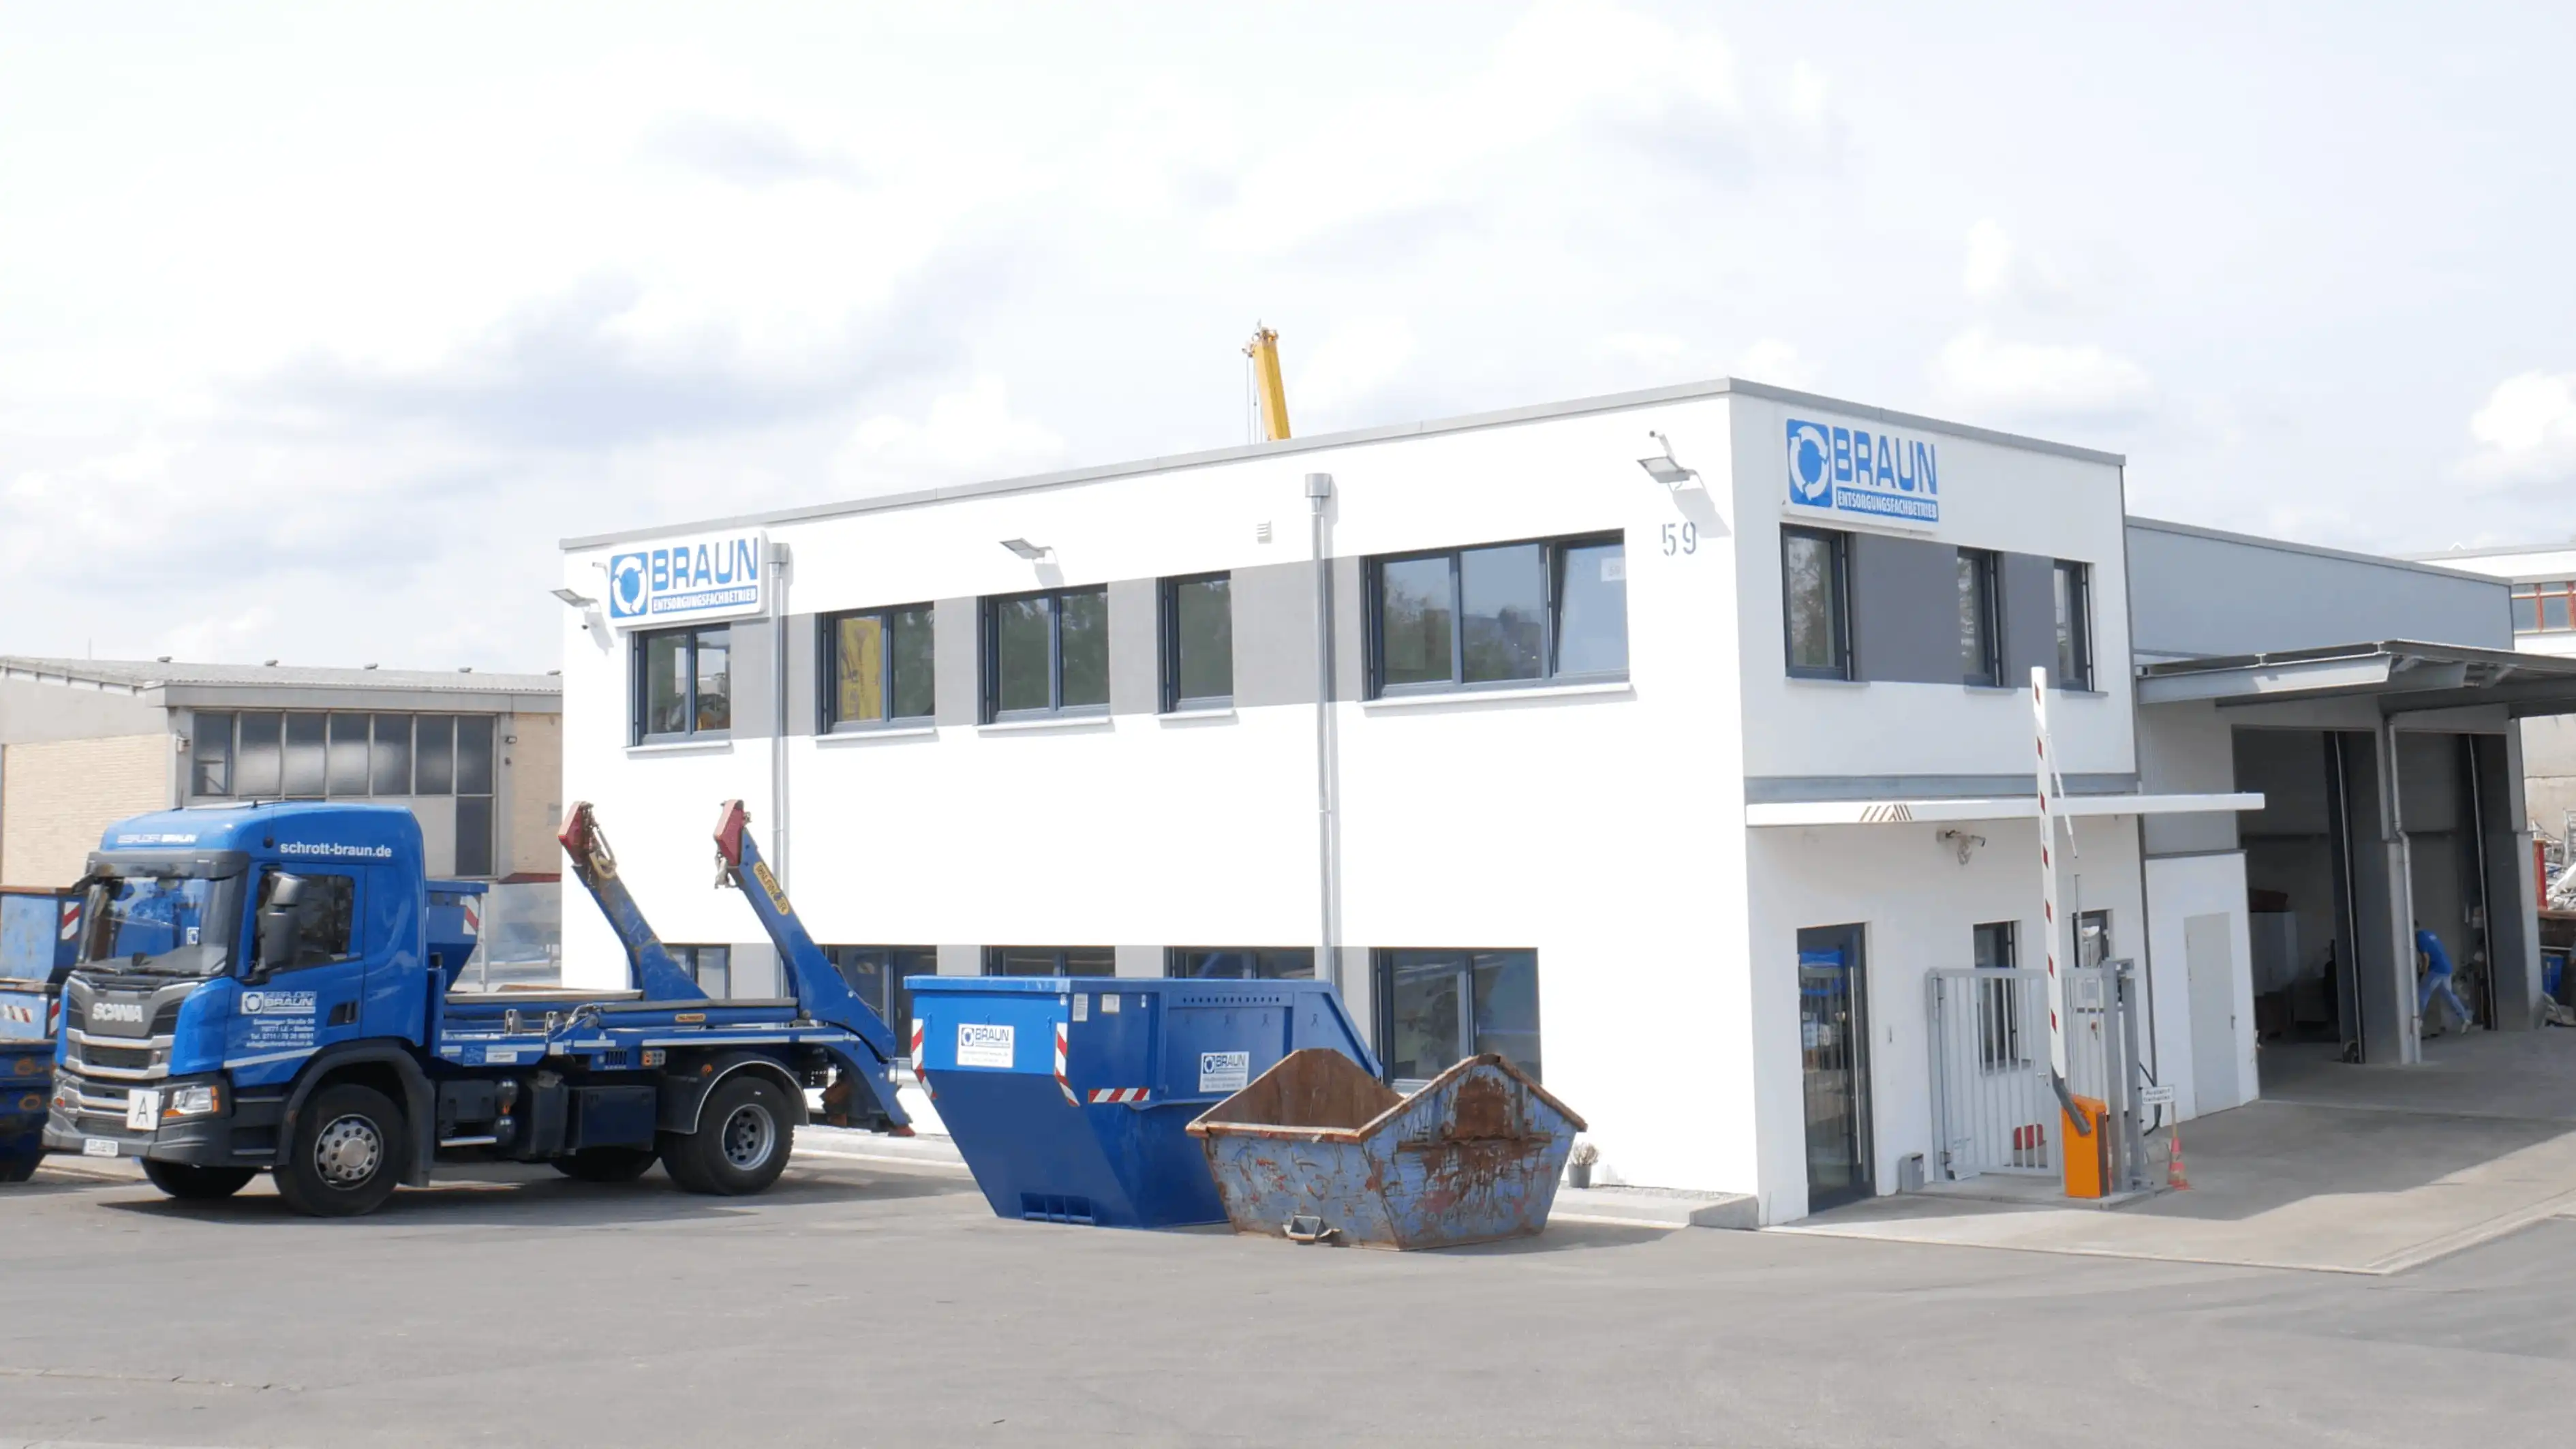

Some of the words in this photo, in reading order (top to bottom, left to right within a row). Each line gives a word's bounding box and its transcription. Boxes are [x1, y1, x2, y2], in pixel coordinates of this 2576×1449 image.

[1833, 426, 1937, 495] BRAUN
[1838, 490, 1937, 519] ENTSORGUNGSFACHBETRIEB
[1661, 521, 1697, 557] 59
[652, 537, 758, 592] BRAUN
[653, 587, 756, 612] ENTSORGUNGSFACHBETRIEB
[280, 841, 392, 857] schrott-braun.de
[92, 1003, 142, 1022] SCANIA
[264, 998, 315, 1006] BRAUN
[975, 1027, 1009, 1041] BRAUN
[1216, 1054, 1245, 1067] BRAUN
[136, 1096, 148, 1124] A
